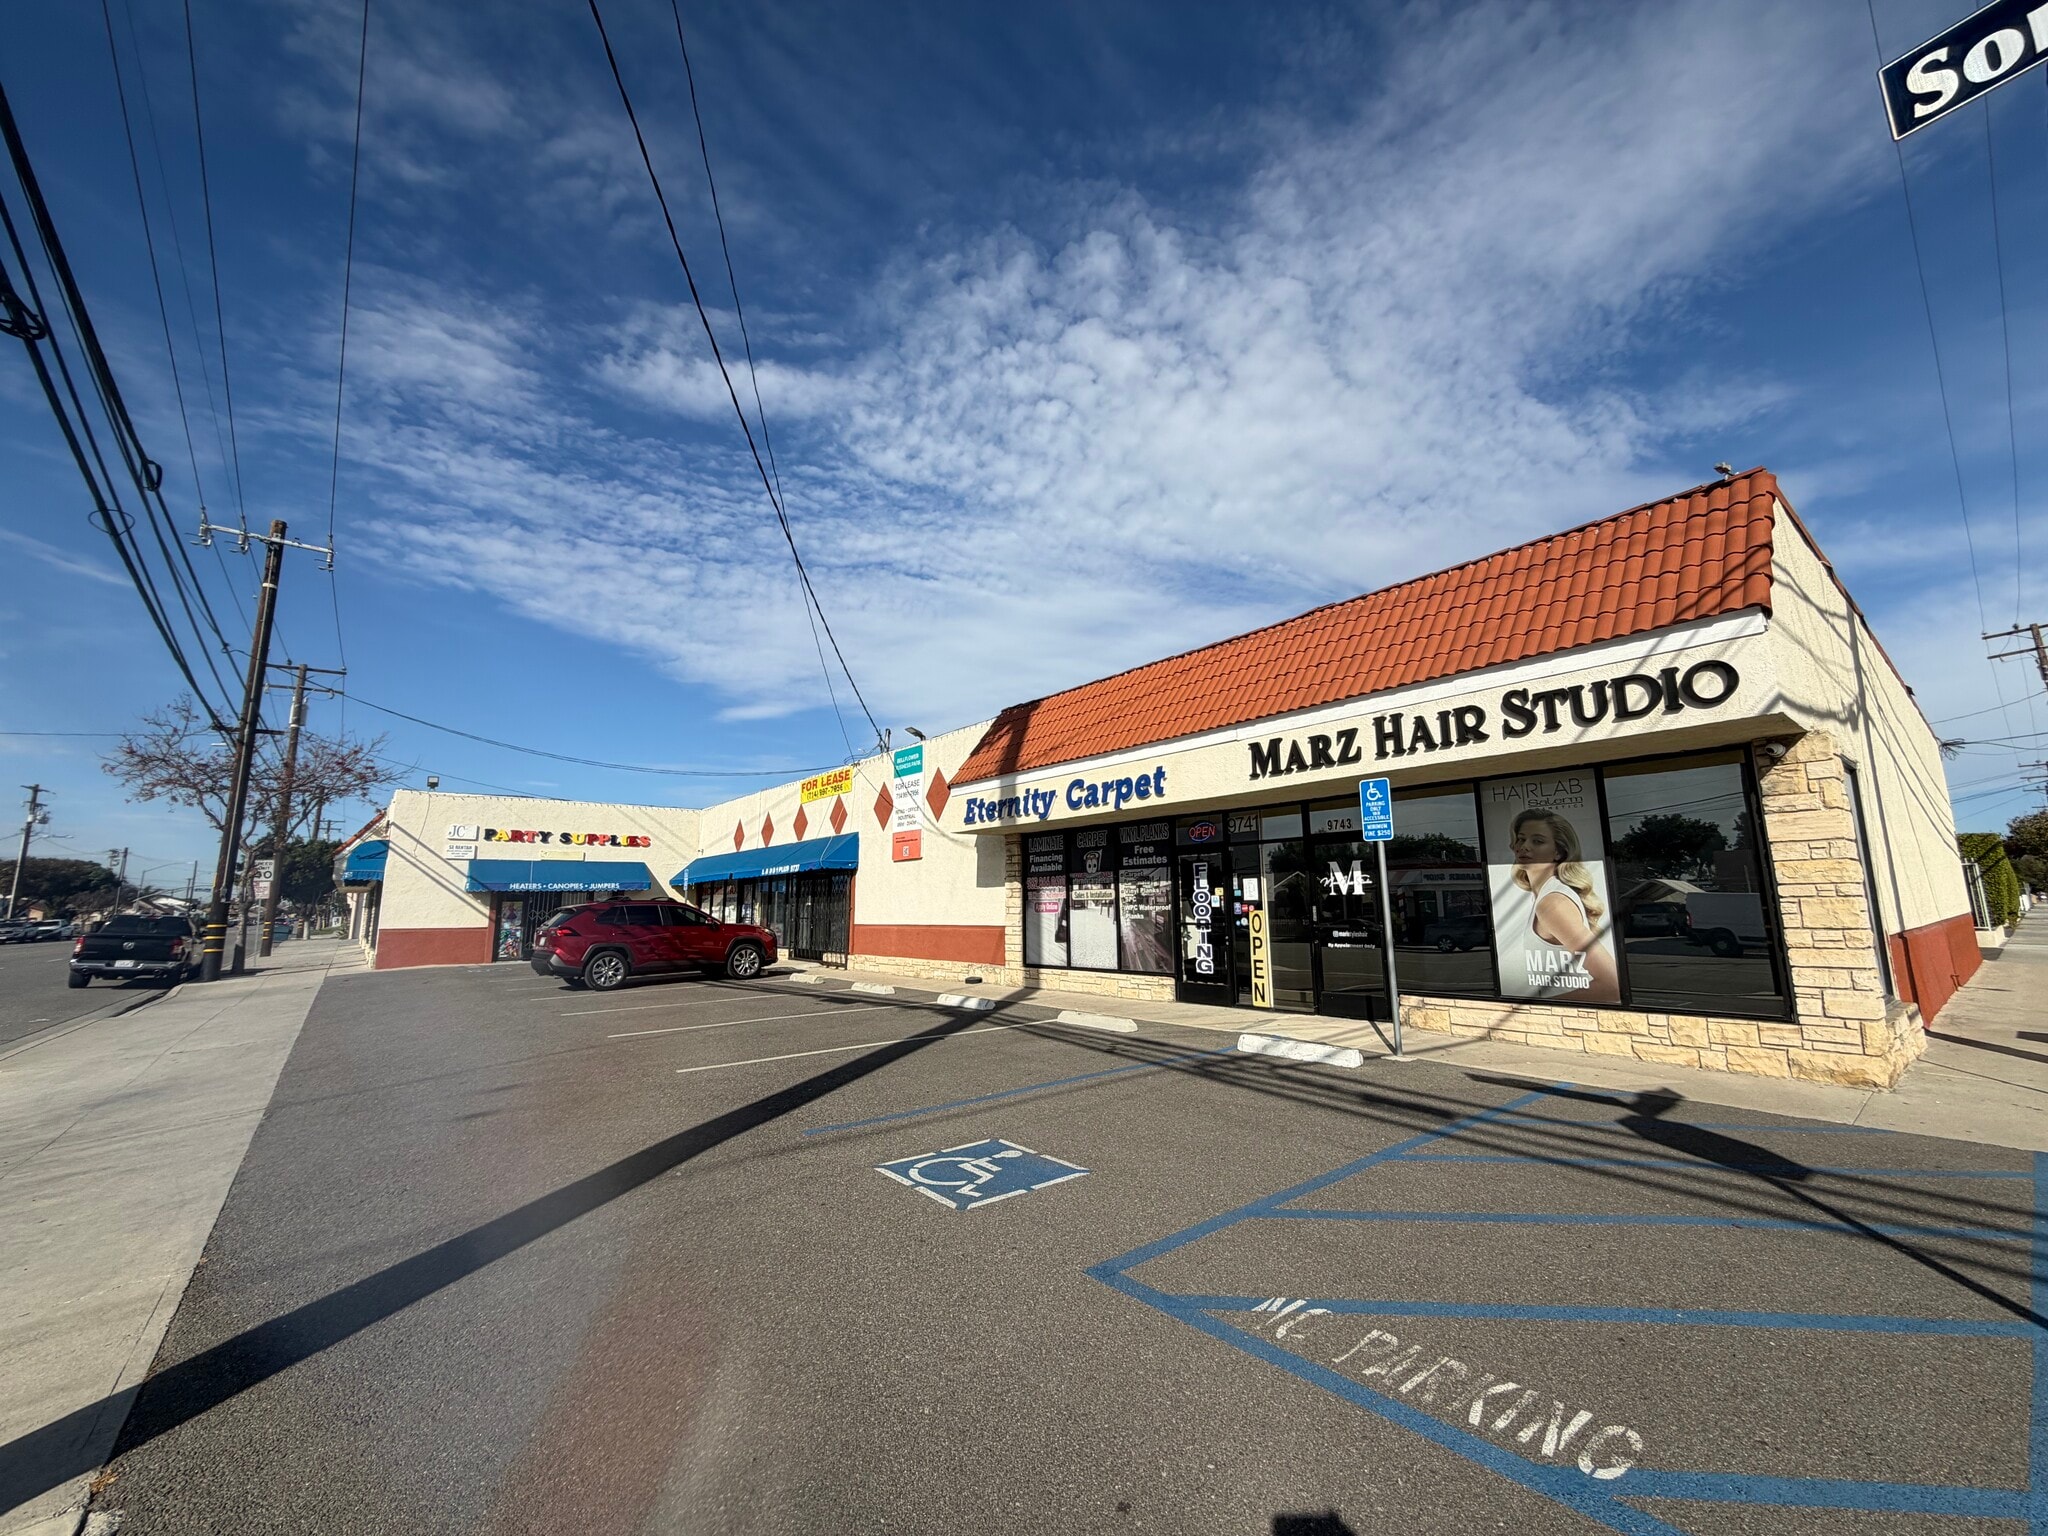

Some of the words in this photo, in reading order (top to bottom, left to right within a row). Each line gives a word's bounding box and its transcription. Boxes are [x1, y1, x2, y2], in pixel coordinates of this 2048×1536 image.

[1248, 728, 1362, 780] MARZ
[1374, 705, 1488, 758] HAIR
[1500, 660, 1739, 740] STUDIO
[801, 781, 817, 793] FOR
[821, 770, 851, 785] LEASE
[964, 788, 1057, 825] Eternity
[1066, 766, 1166, 811] Carpet
[448, 825, 465, 837] JC
[1120, 826, 1139, 843] VINYL
[1140, 823, 1169, 841] PLANKS
[1189, 825, 1216, 838] OPEN
[1228, 815, 1258, 833] 9741
[1327, 818, 1352, 830] 9743
[484, 829, 553, 843] PARTY
[560, 832, 651, 847] SUPPLIES
[1077, 830, 1107, 848] CARPET
[1030, 853, 1063, 863] Financing
[1134, 845, 1154, 854] Free
[1030, 863, 1062, 873] Available
[1123, 856, 1167, 866] Estimates
[1139, 903, 1171, 911] Waterproof
[1193, 863, 1213, 974] FLOORING
[1251, 913, 1266, 1002] OPEN
[1525, 950, 1588, 974] MARZ
[1528, 974, 1551, 987] HAIR
[1553, 976, 1590, 989] STUDIO
[1332, 1329, 1643, 1480] PARKING
